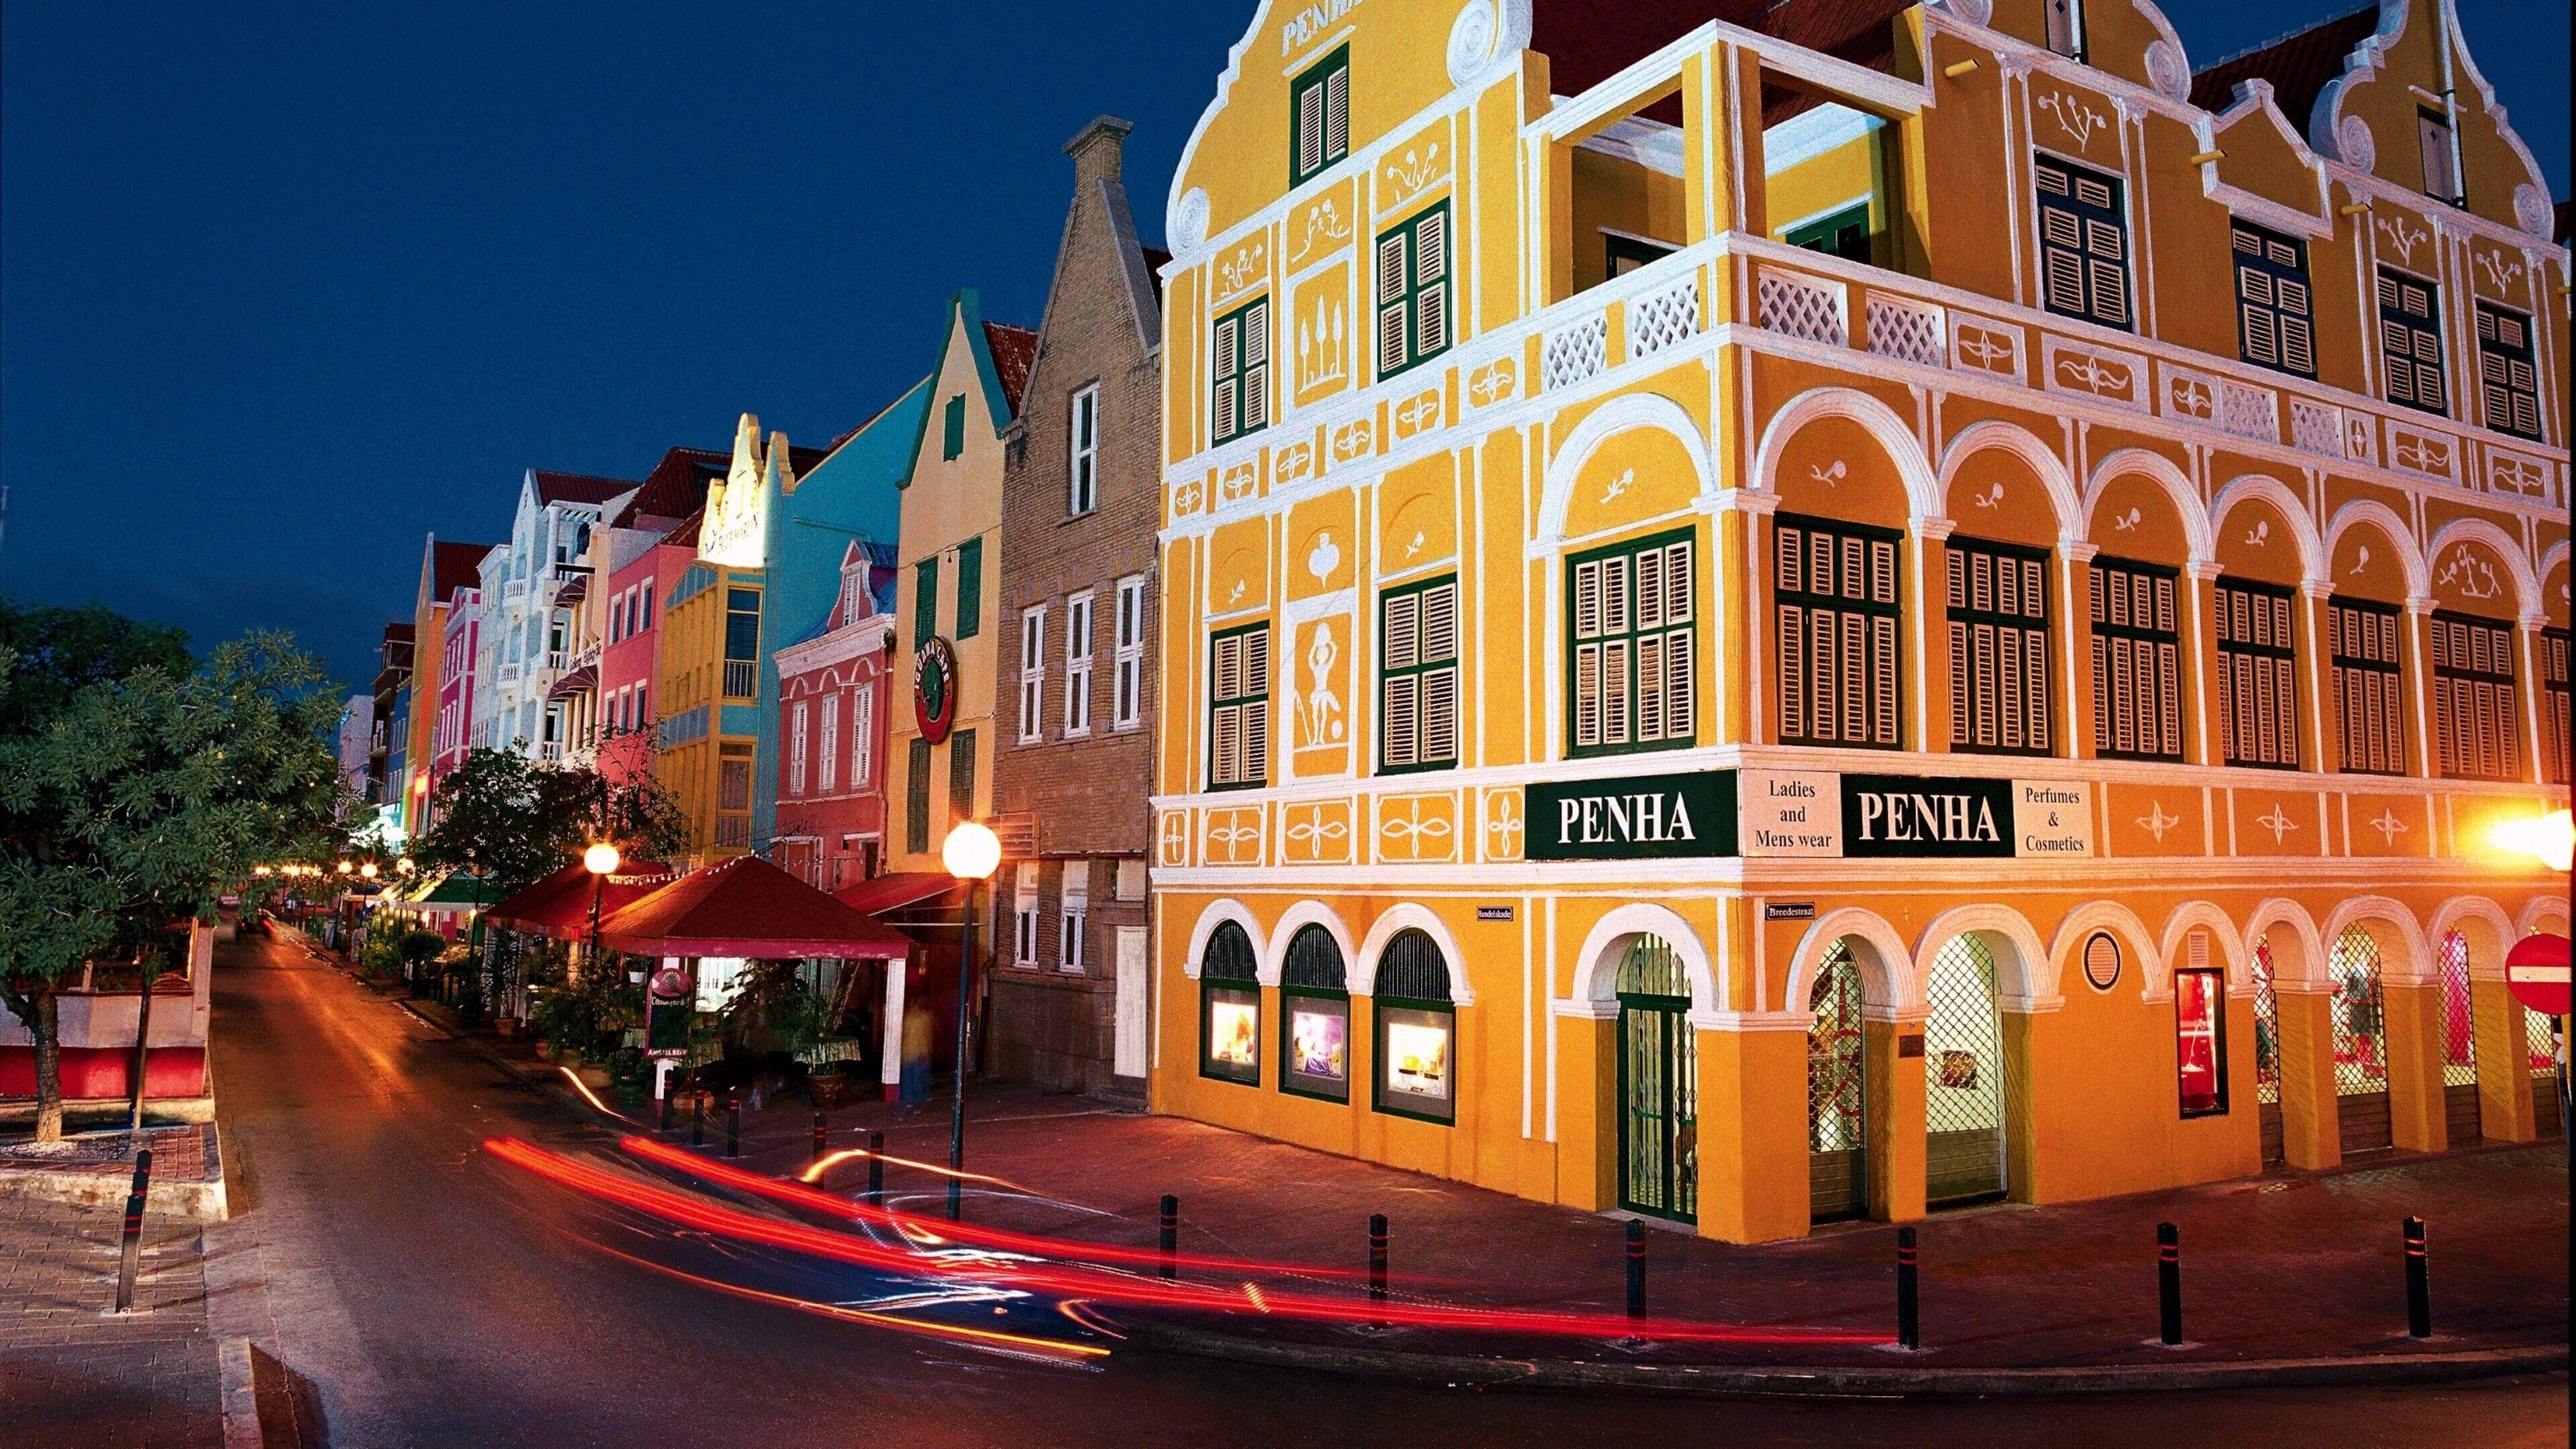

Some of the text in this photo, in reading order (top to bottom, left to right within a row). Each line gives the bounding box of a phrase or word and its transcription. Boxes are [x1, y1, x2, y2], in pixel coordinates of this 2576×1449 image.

[914, 641, 935, 690] IGUANA
[1769, 780, 1815, 798] Ladies
[2026, 787, 2080, 804] Perfumes
[1558, 791, 1697, 844] PENHA
[1780, 806, 1806, 822] and
[1857, 793, 2001, 842] PENHA
[2048, 811, 2059, 827] &
[1756, 830, 1832, 847] Mens wear
[2026, 835, 2084, 851] Cosmetics
[1769, 908, 1813, 916] Breedestraat
